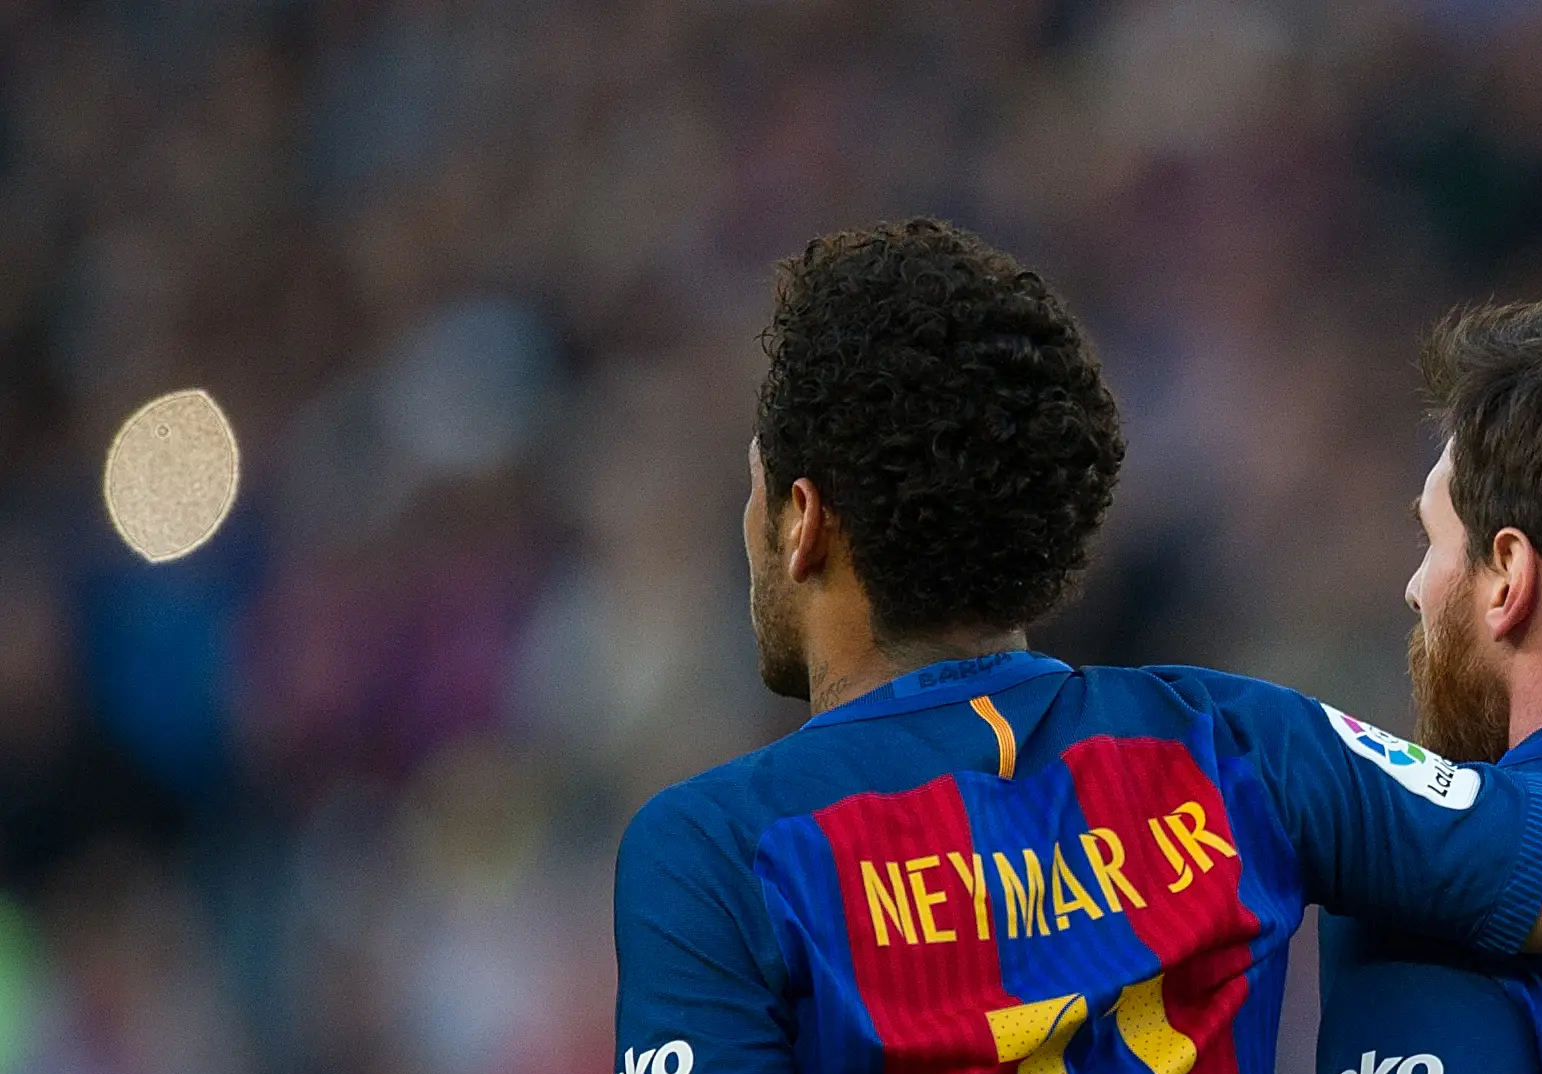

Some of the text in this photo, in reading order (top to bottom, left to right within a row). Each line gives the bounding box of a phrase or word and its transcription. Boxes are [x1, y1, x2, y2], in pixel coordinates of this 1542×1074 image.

[1427, 757, 1458, 798] LaLi
[860, 801, 1237, 947] NEYMAR JR
